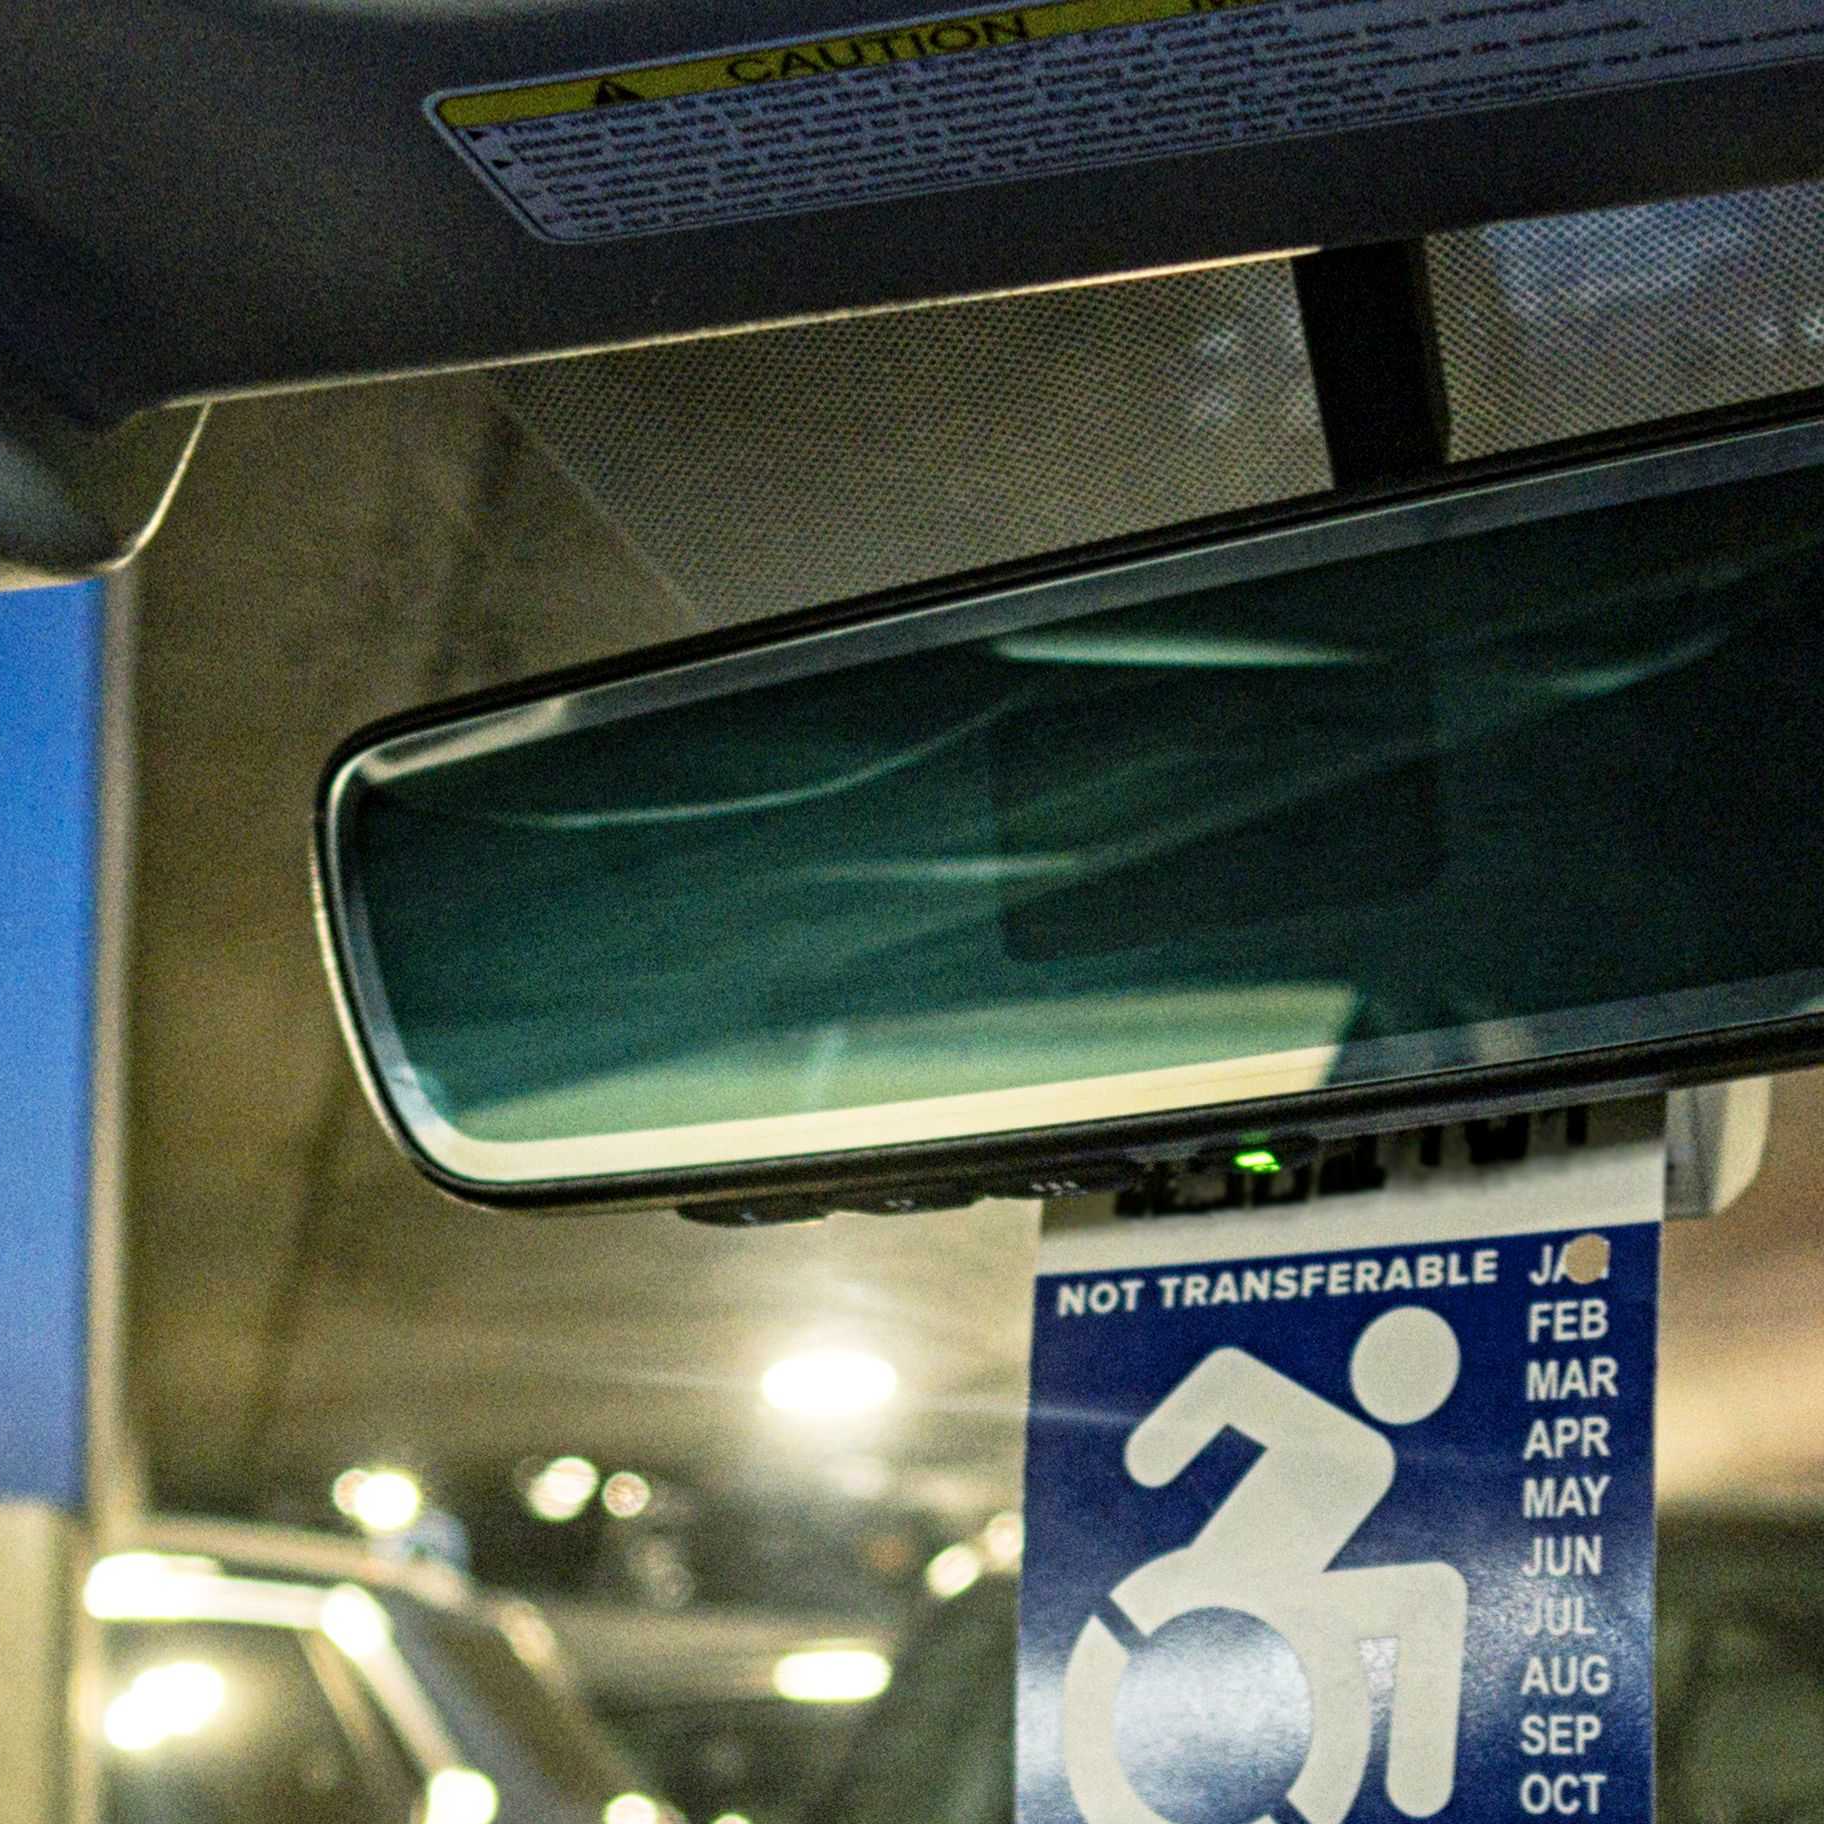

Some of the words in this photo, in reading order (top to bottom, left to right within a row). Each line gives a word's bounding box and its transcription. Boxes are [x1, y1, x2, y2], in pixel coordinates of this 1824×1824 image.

[725, 12, 1029, 83] CAUTION
[1057, 1279, 1144, 1316] NOT
[1159, 1249, 1499, 1309] TRANSFERABLE
[1529, 1241, 1610, 1286] JA
[1527, 1299, 1608, 1343] FEB
[1525, 1357, 1618, 1401] MAR
[1522, 1417, 1612, 1461] APR
[1522, 1476, 1611, 1518] MAY
[1523, 1536, 1603, 1577] JUN
[1522, 1596, 1596, 1636] JUL
[1520, 1655, 1611, 1697] AUG
[1520, 1714, 1600, 1756] SEP
[1520, 1773, 1606, 1815] OCT
